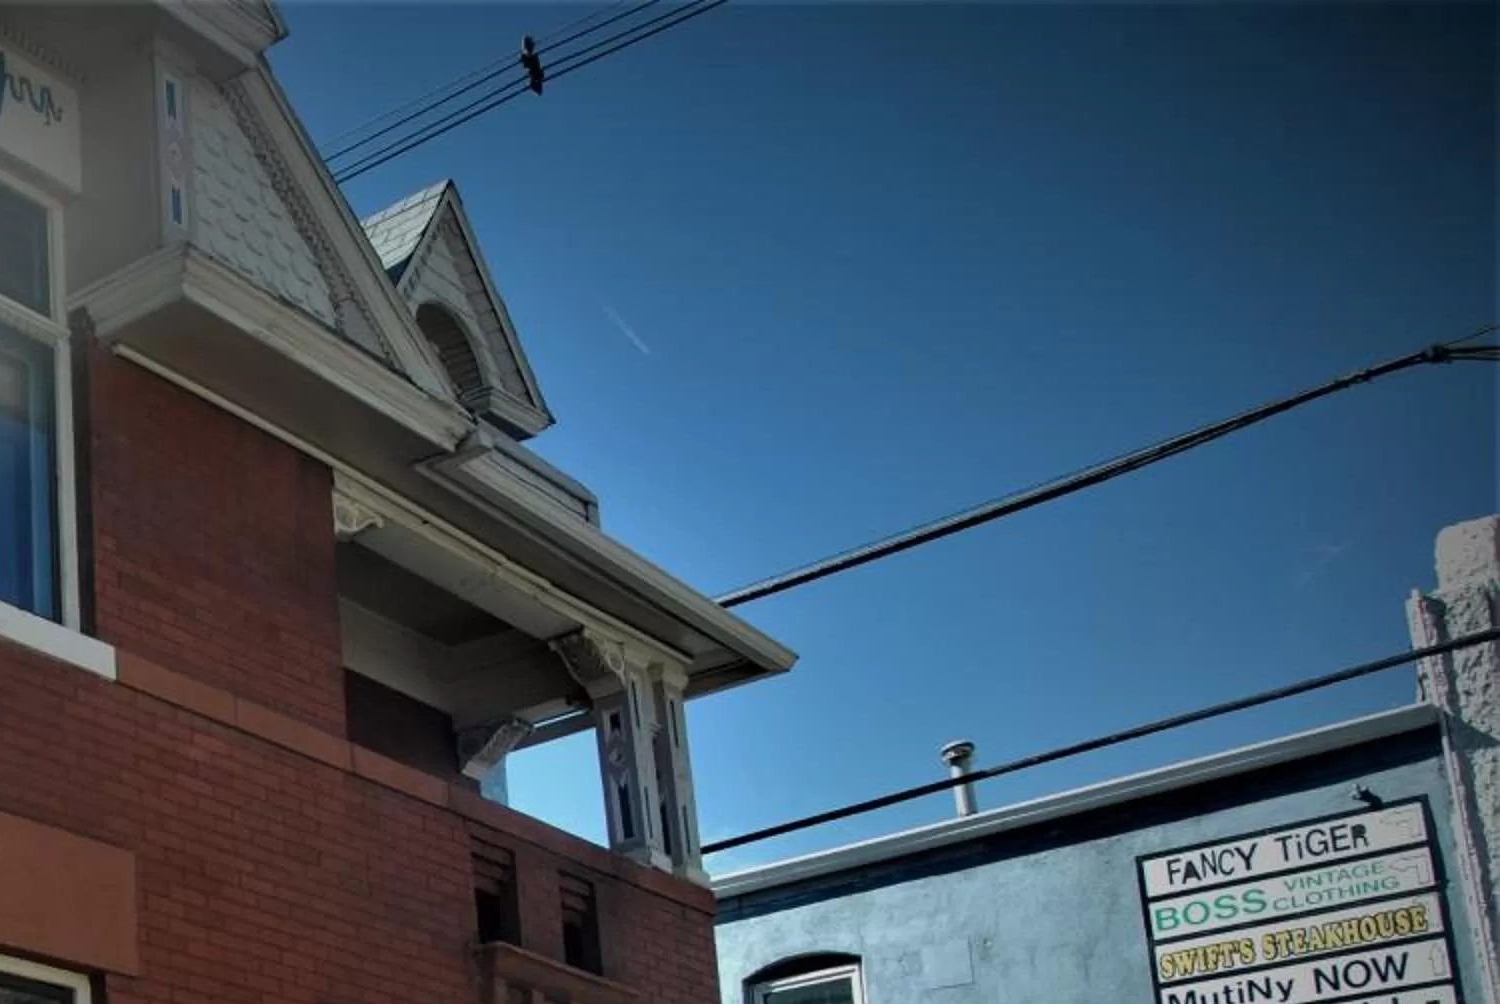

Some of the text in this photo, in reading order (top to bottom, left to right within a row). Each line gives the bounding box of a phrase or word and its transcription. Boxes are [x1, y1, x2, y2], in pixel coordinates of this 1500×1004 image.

[1166, 843, 1257, 885] FANCY
[1284, 861, 1384, 891] VINTAGE
[1155, 889, 1267, 931] BOSS
[1273, 876, 1400, 912] CLOTHING
[1160, 904, 1428, 979] SWIFT'S STEAKHOUSE
[1313, 951, 1409, 994] NOW
